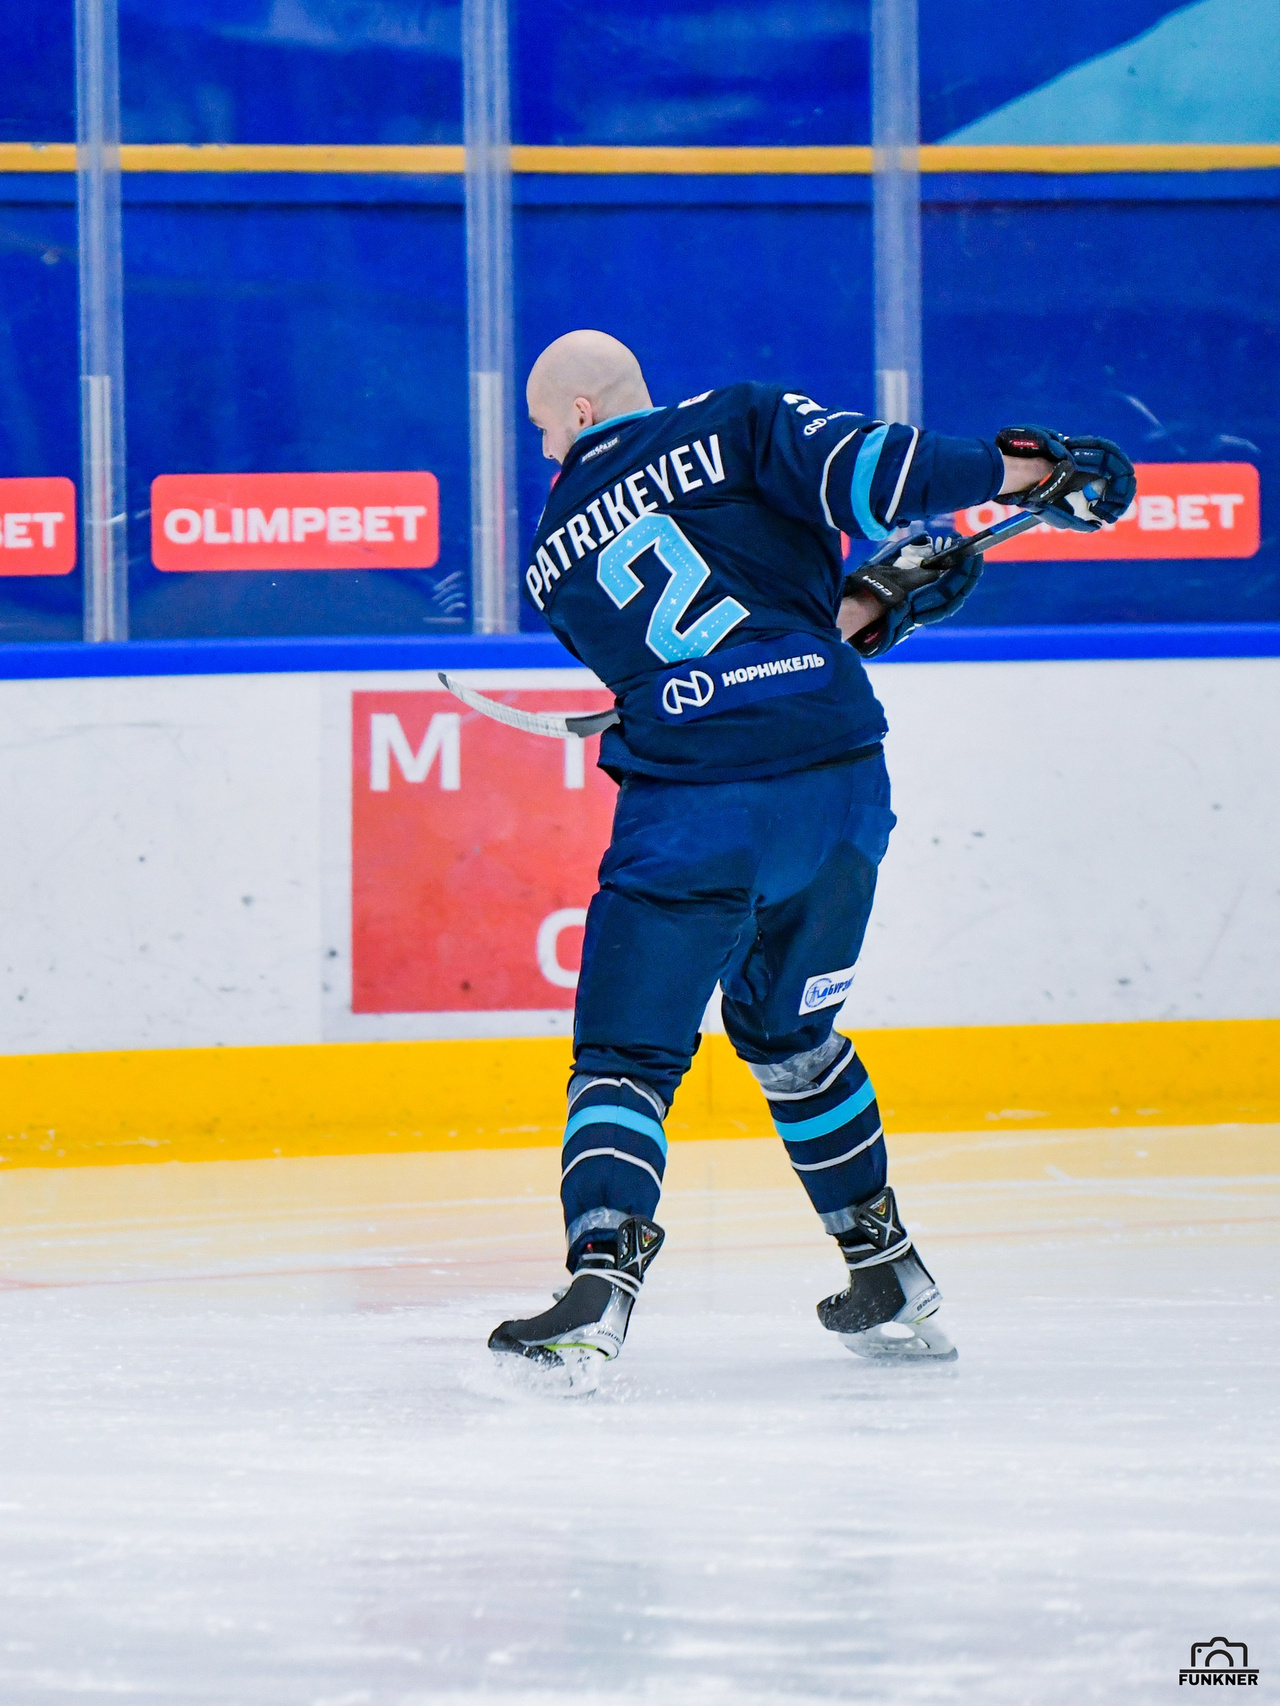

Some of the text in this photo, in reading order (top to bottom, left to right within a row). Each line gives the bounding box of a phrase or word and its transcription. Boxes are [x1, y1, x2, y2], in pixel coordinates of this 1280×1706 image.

[164, 506, 426, 544] OLIMPBET
[525, 434, 726, 610] PATRIKEYEV
[965, 494, 1244, 534] OBET
[597, 512, 751, 664] 2
[721, 653, 825, 687] НОРНИКЕЛЬ
